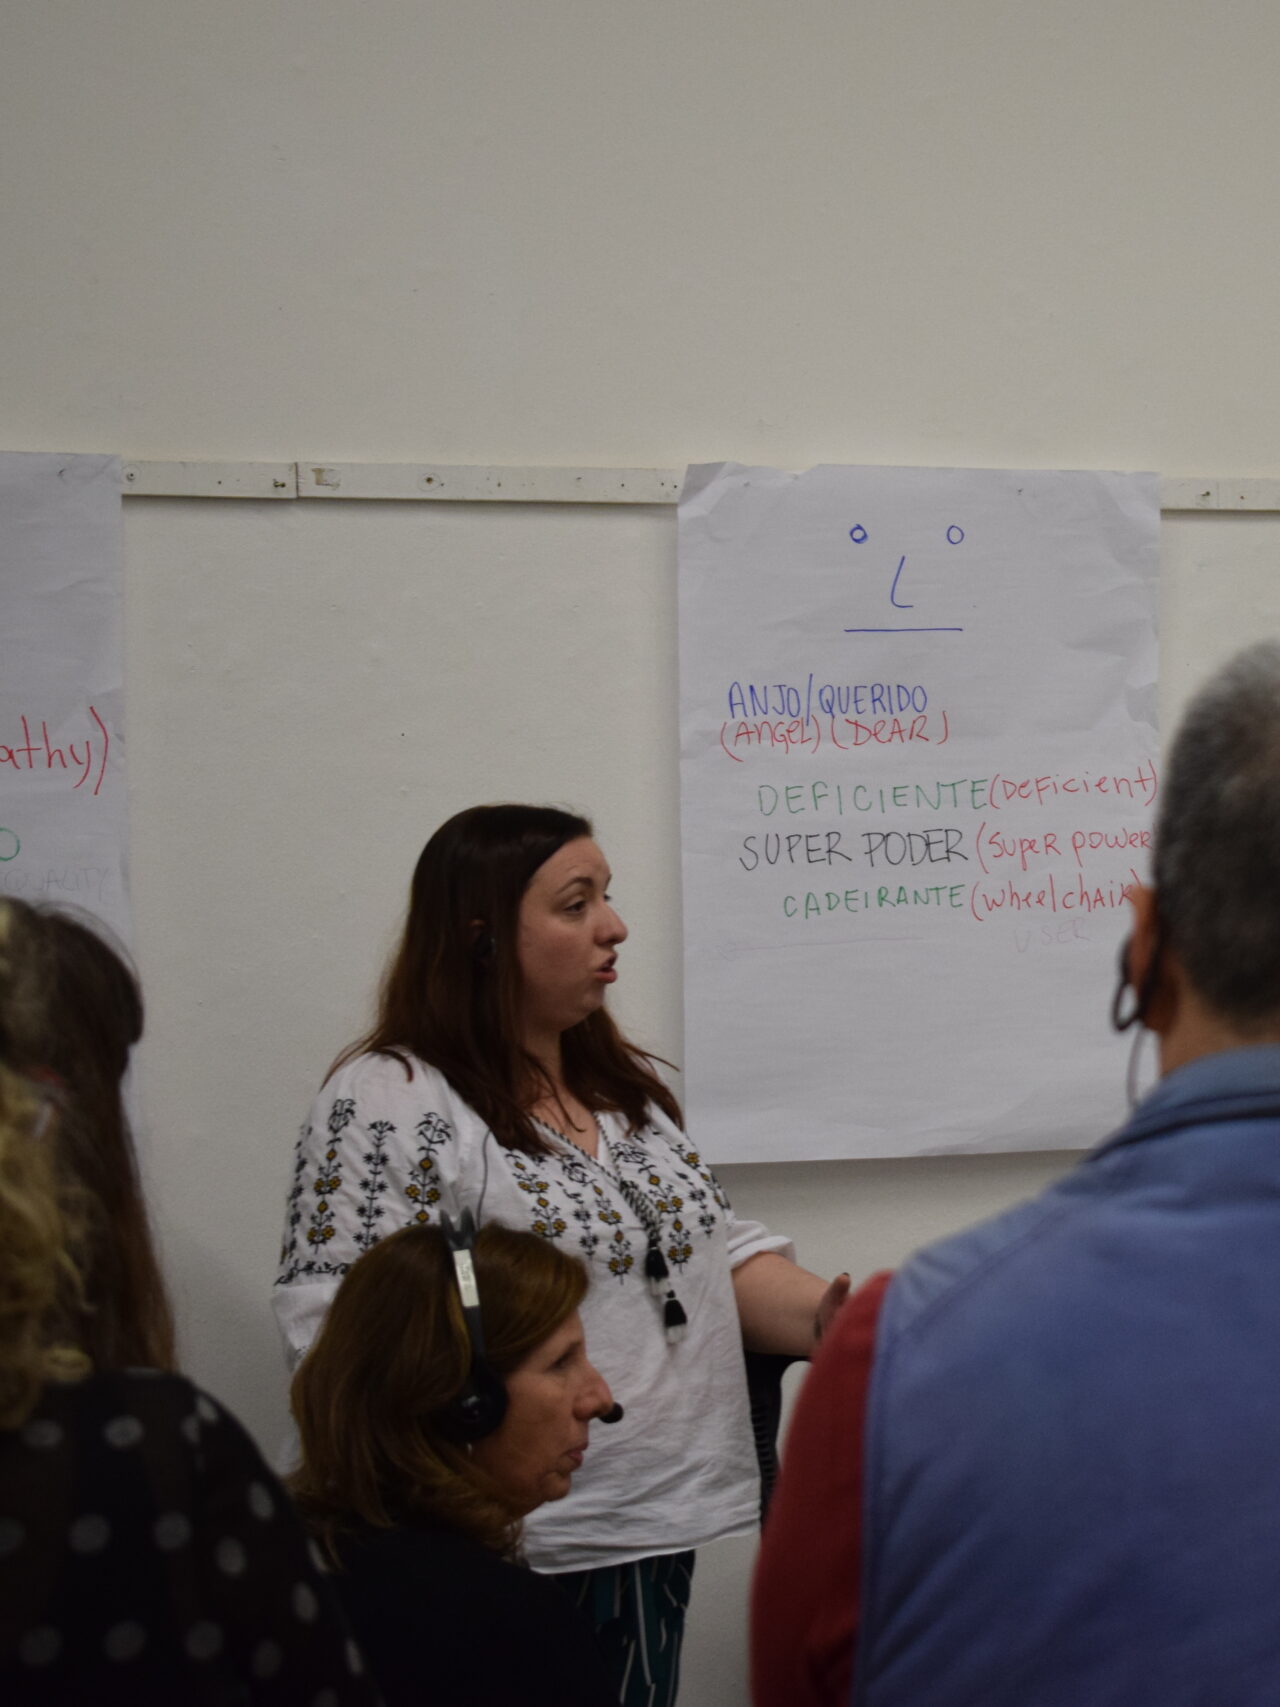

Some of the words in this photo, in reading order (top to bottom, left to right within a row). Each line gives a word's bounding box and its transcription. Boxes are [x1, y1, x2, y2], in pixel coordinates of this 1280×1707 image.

[0, 706, 110, 797] athy)
[757, 778, 989, 816] DEFICIENTE
[738, 831, 852, 872] SUPER
[861, 829, 969, 868] PODER
[783, 884, 966, 920] CADEIRANTE
